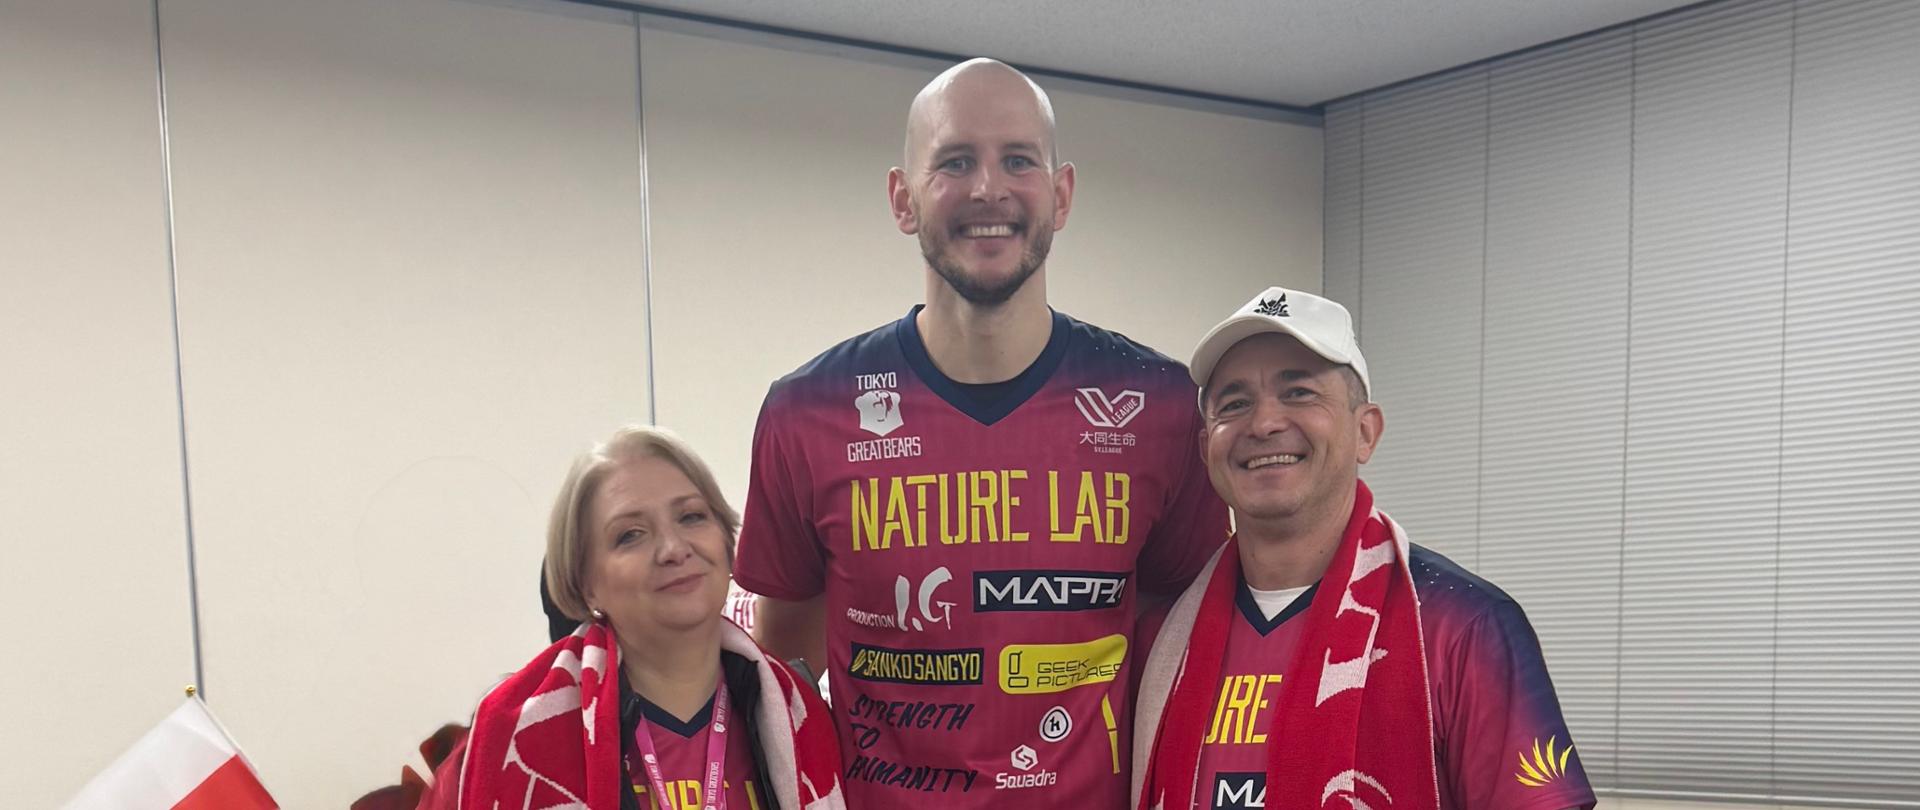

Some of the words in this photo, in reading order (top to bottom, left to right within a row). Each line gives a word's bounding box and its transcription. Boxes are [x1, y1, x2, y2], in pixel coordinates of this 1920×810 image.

[855, 371, 897, 391] TOKYO
[1111, 398, 1138, 424] LEAGUE
[847, 436, 922, 462] GREATBEARS
[1079, 431, 1136, 447] 大同生命
[851, 470, 1030, 551] NATURE
[1048, 470, 1131, 545] LAB
[847, 608, 895, 628] PRODUCTION
[863, 650, 913, 680] SANKO
[914, 653, 980, 681] SANGYO
[1037, 658, 1091, 674] GEEK
[849, 694, 975, 730] STRENGTH
[850, 723, 881, 749] TO
[847, 755, 978, 793] HUMANITY
[995, 769, 1057, 789] Squadra
